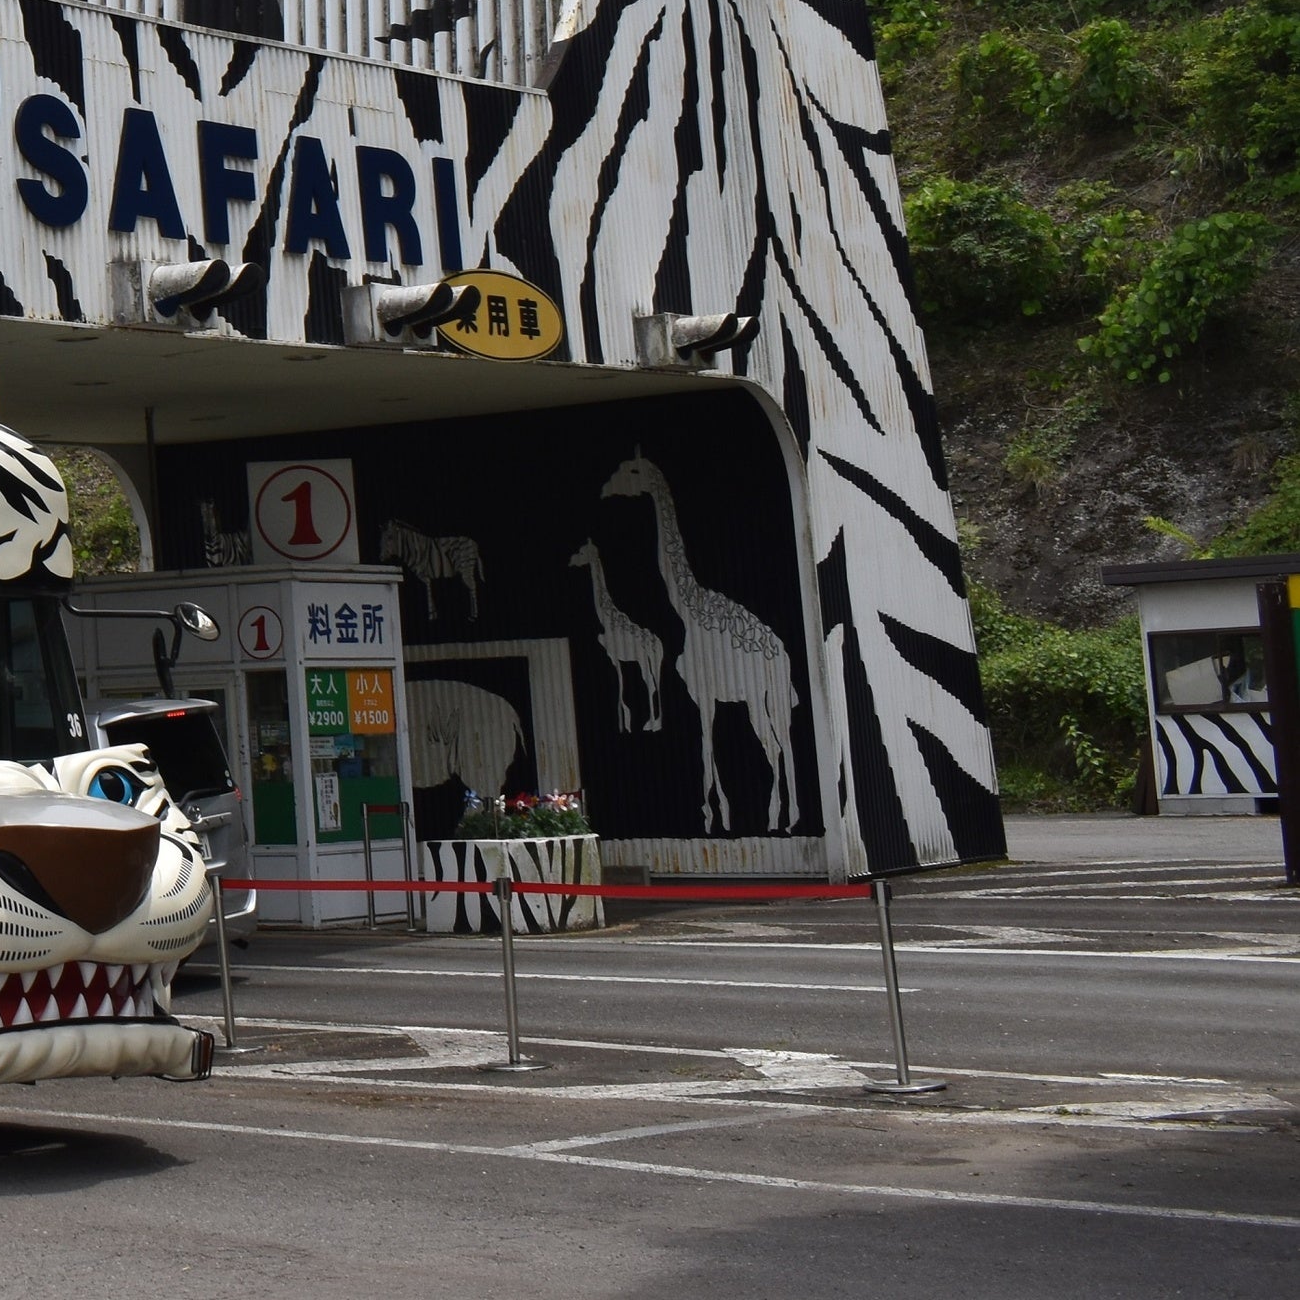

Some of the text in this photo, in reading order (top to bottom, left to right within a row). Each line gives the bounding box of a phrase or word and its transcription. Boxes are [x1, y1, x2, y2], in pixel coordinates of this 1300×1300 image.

[14, 94, 463, 270] SAFARI
[281, 481, 322, 545] 1
[250, 614, 270, 651] 1
[307, 602, 384, 644] 料金所
[310, 674, 338, 694] 大人
[356, 674, 383, 694] 小人
[67, 713, 83, 738] 36
[308, 710, 344, 726] ¥2900
[354, 709, 389, 725] ¥1500
